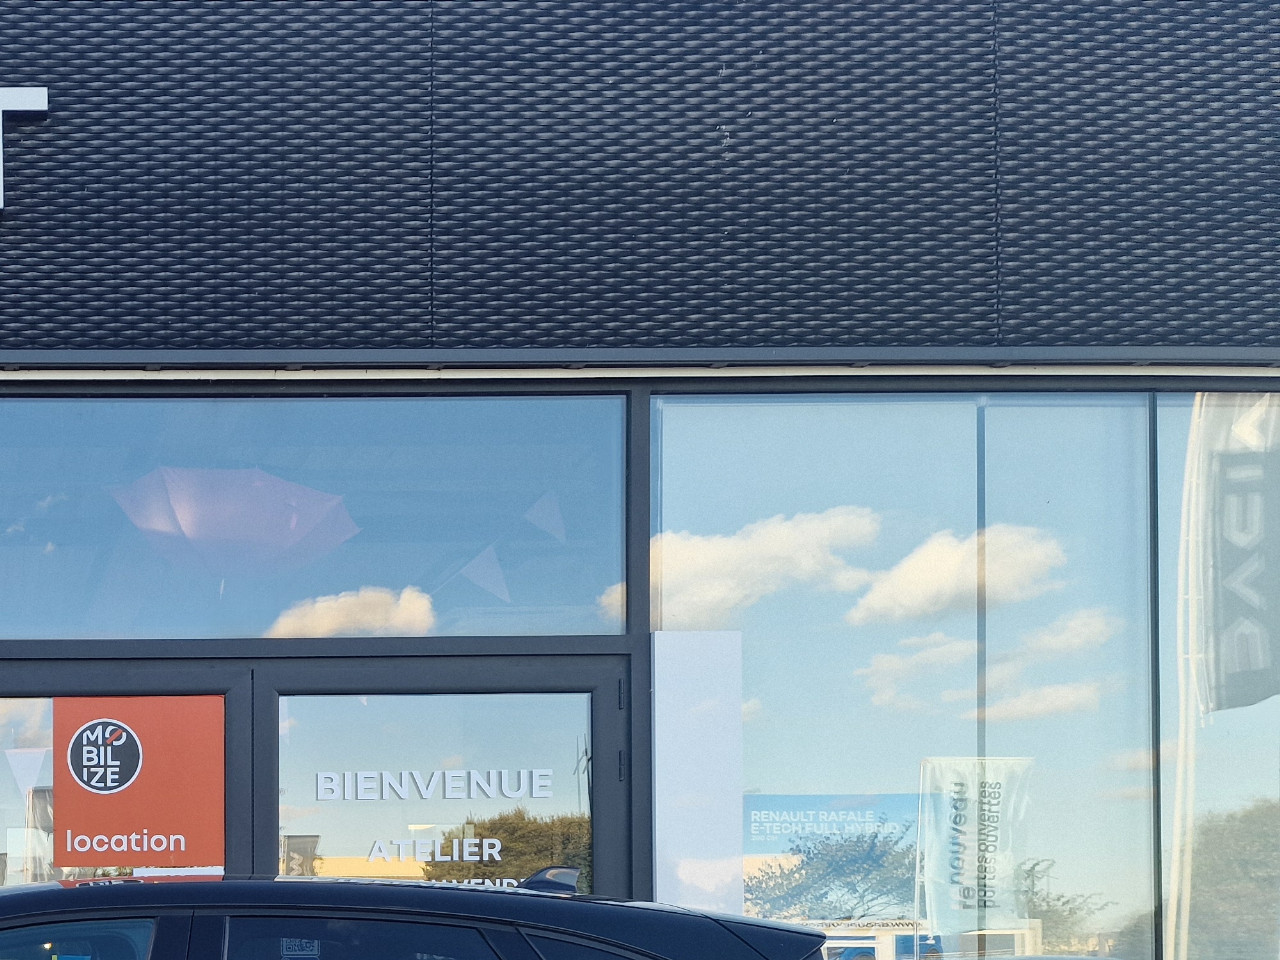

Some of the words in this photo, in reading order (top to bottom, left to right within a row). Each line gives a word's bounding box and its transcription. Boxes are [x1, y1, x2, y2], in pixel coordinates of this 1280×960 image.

[315, 768, 554, 801] BIENVENUE
[750, 811, 816, 822] RENAULT
[818, 811, 875, 822] RAFALE
[750, 823, 802, 834] E-TECH
[805, 823, 841, 834] FULL
[66, 829, 186, 852] location
[368, 838, 503, 863] ATELIER
